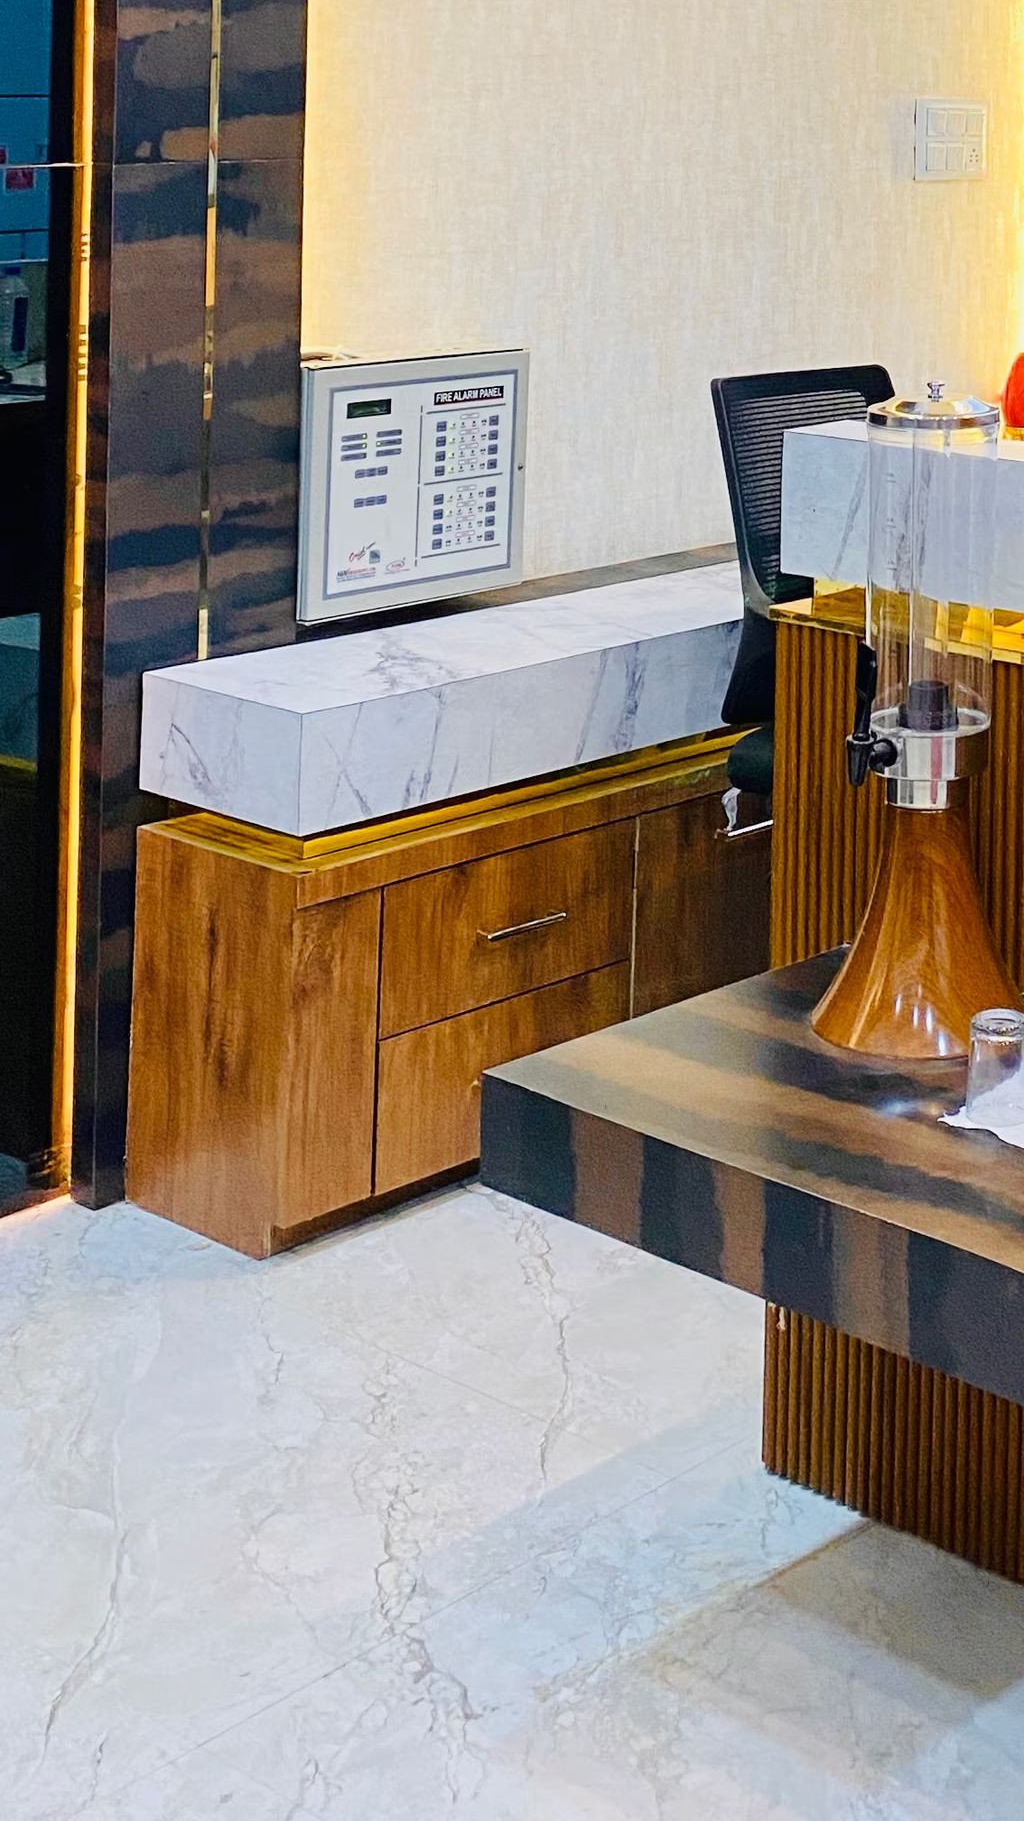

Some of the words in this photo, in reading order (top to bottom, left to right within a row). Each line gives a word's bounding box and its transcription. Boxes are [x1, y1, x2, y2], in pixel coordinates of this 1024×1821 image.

[436, 391, 453, 403] FIRE
[453, 389, 479, 401] ALARM
[479, 387, 502, 398] PANEL
